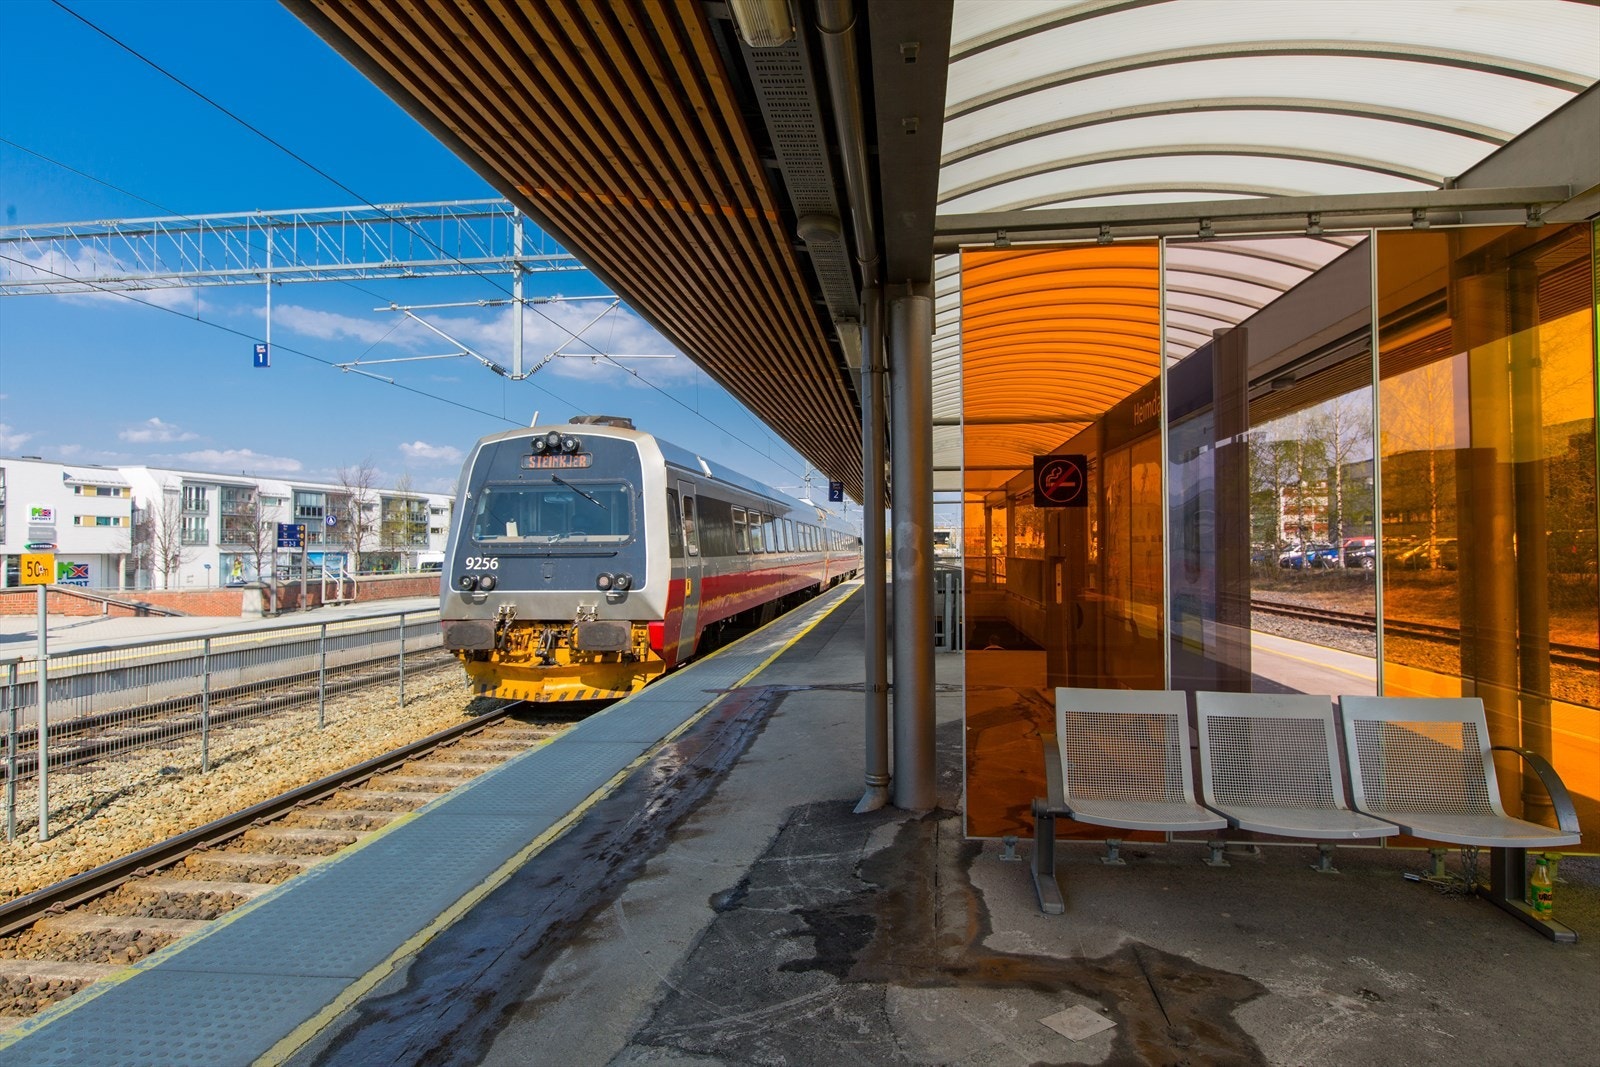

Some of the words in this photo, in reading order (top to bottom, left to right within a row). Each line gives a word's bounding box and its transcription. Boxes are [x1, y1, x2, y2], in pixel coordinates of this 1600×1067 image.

[258, 353, 263, 363] 1
[833, 490, 839, 499] 2
[465, 556, 499, 570] 9256
